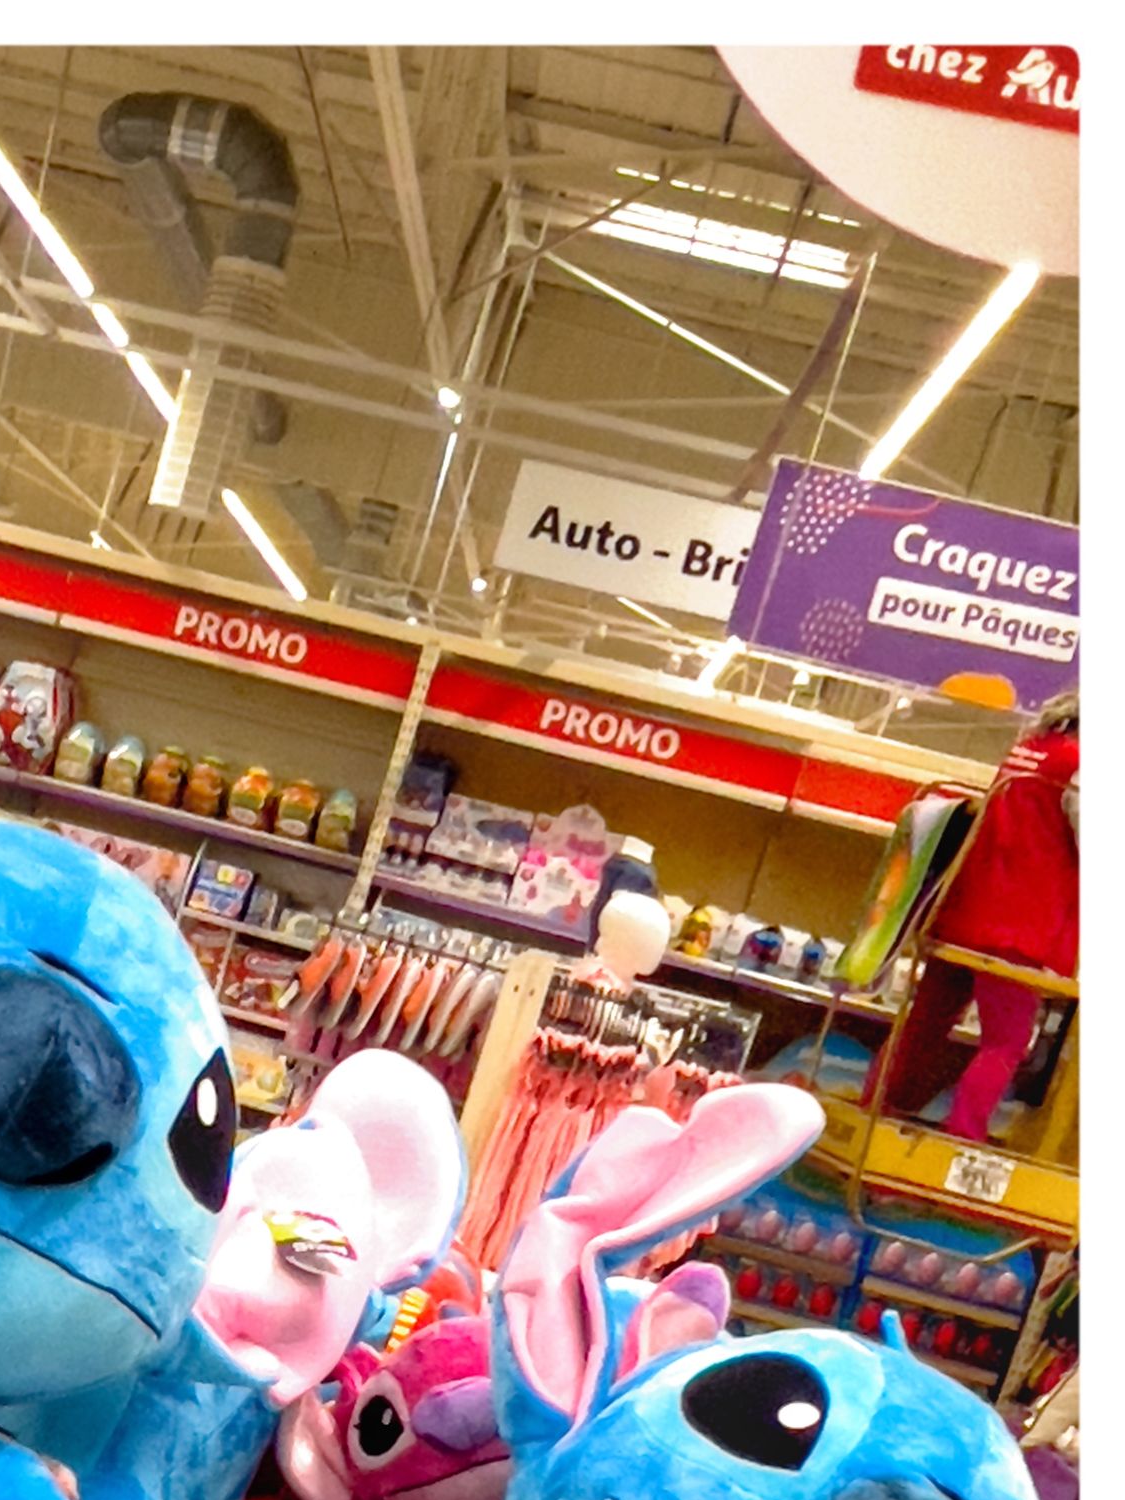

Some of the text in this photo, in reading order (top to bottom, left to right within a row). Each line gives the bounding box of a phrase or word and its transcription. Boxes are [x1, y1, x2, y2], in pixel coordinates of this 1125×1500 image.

[885, 45, 988, 83] chez
[528, 505, 641, 561] Auto
[893, 523, 1078, 601] Craquez
[175, 605, 308, 664] PROMO
[878, 593, 1076, 649] pour Pâques
[539, 698, 681, 760] PROMO
